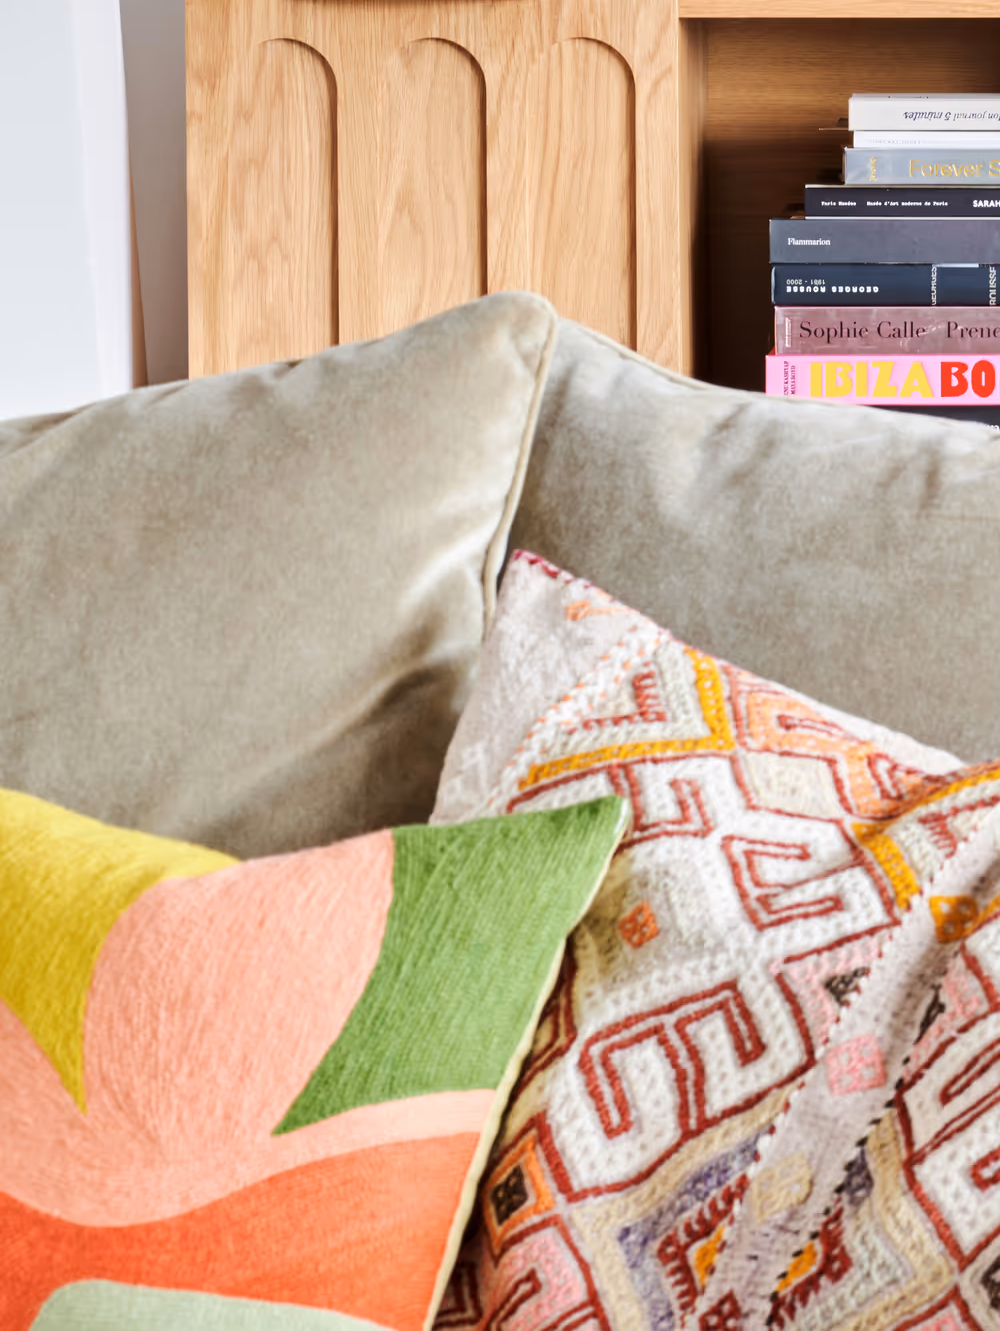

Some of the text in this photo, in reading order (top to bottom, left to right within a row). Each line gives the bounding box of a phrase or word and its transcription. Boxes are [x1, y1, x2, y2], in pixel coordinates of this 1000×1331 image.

[903, 111, 944, 120] minutes
[944, 111, 951, 121] 5
[953, 110, 988, 121] journal
[909, 159, 983, 177] Forever
[787, 237, 831, 246] Flammarion
[799, 320, 869, 344] Sophie
[877, 320, 926, 338] Calle
[810, 361, 934, 398] IBIZA
